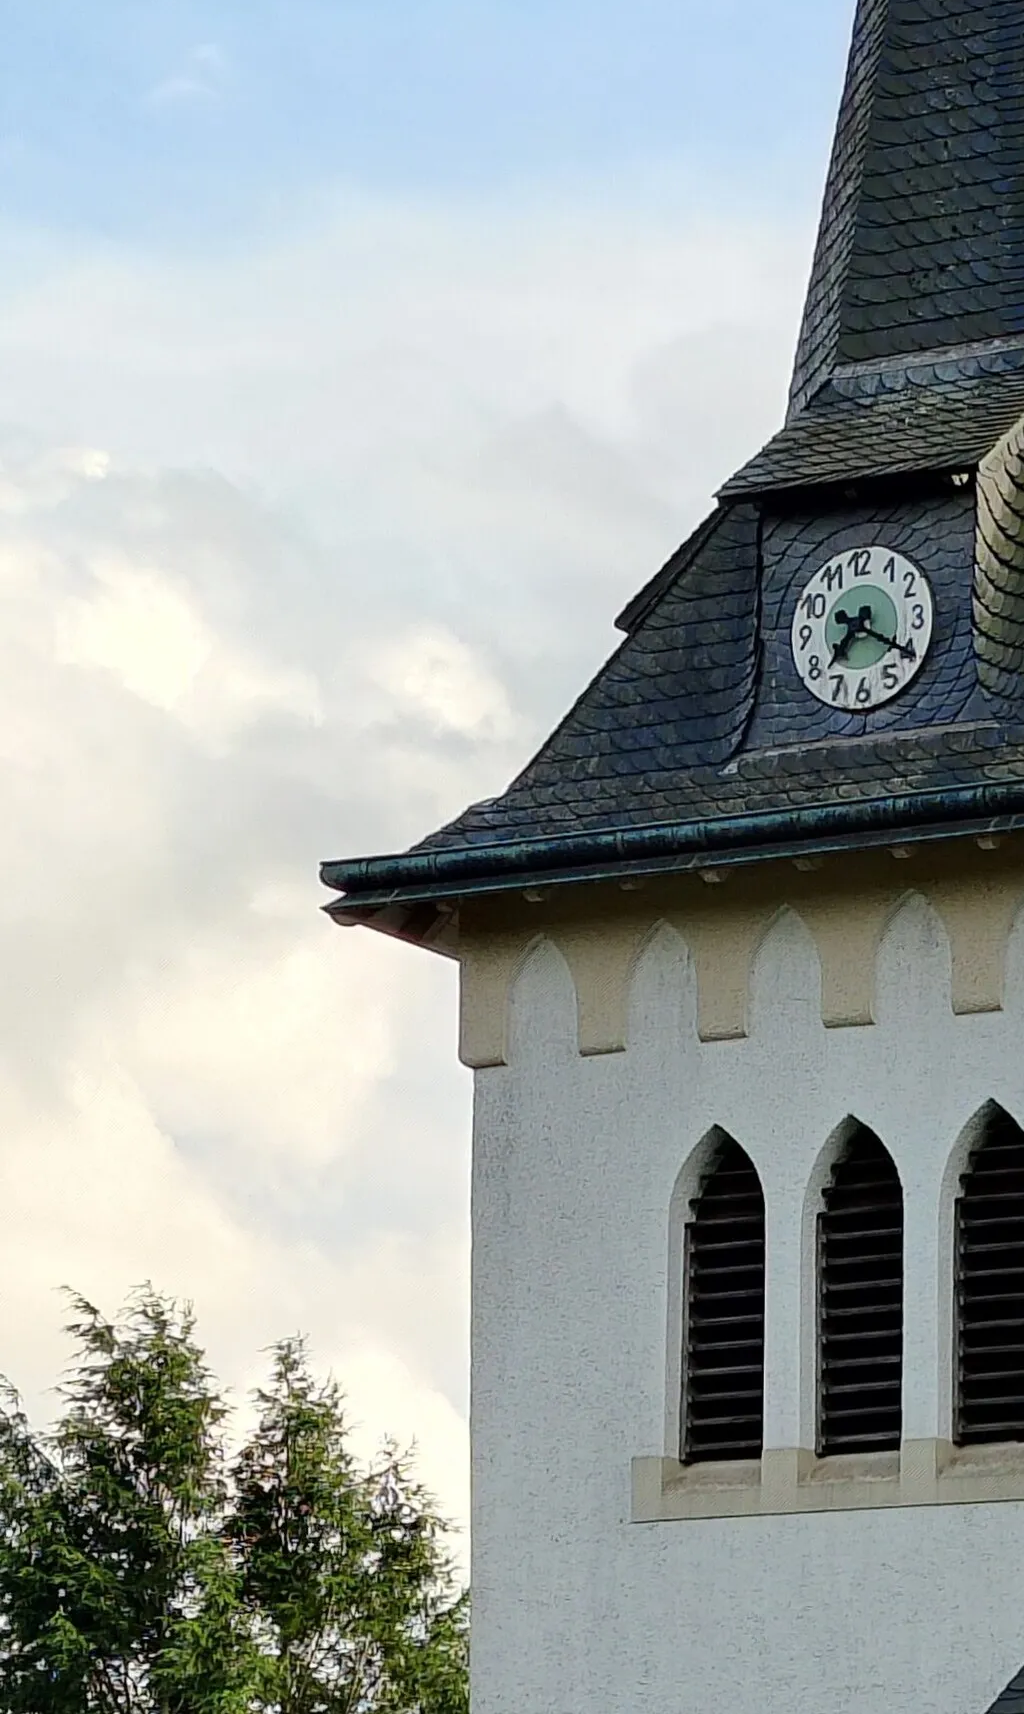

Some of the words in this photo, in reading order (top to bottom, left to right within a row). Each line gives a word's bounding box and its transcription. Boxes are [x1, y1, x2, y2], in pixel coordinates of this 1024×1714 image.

[848, 550, 871, 577] 12
[883, 557, 895, 582] 1
[820, 564, 843, 591] 11
[903, 572, 916, 598] 2
[801, 594, 825, 618] 10
[912, 604, 923, 629] 3
[799, 625, 812, 651] 9
[809, 655, 820, 680] 8
[883, 664, 898, 689] 5
[829, 675, 844, 701] 7
[856, 677, 871, 703] 6
